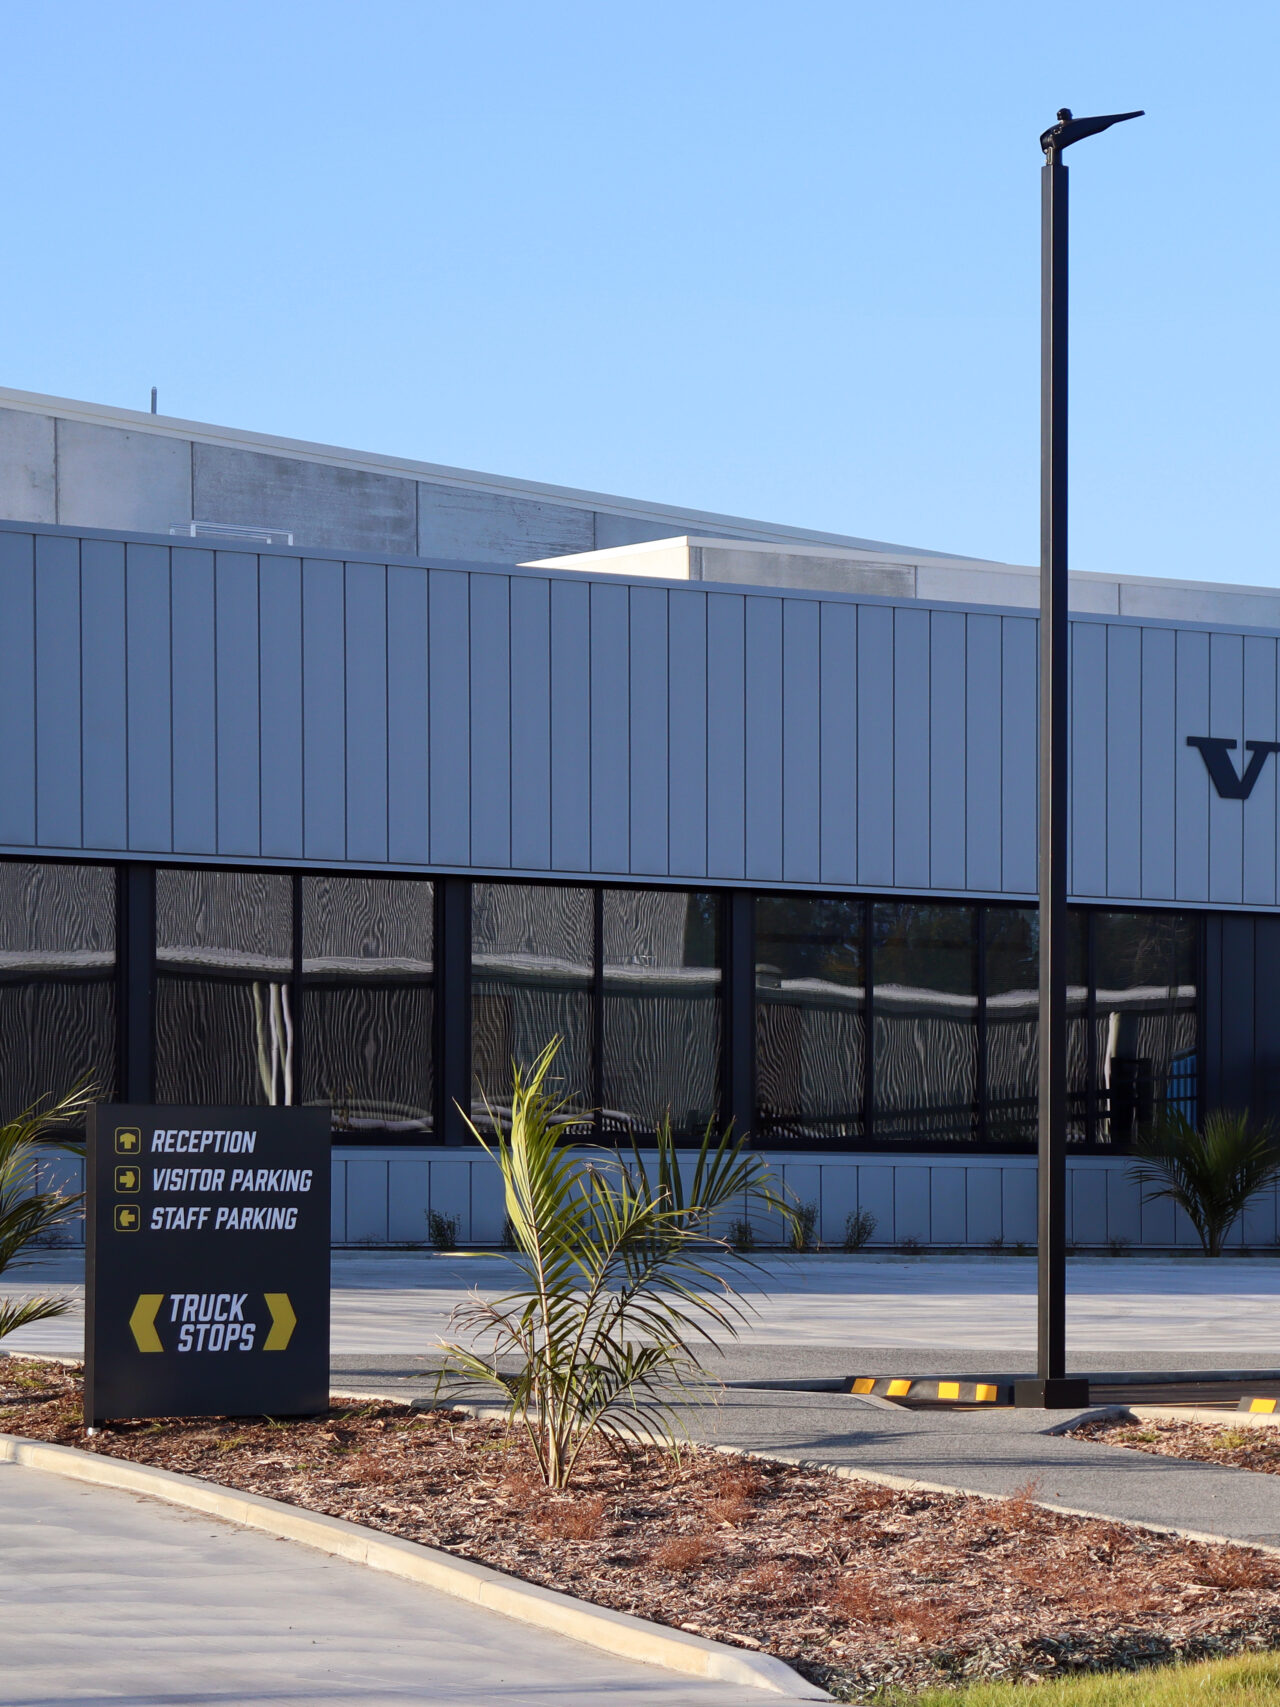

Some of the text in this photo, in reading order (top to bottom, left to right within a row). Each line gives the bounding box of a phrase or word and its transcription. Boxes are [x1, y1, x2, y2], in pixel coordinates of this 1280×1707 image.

[151, 1130, 257, 1153] RECEPTION
[152, 1168, 313, 1192] VISITOR PARKING
[150, 1207, 298, 1230] STAFF PARKING
[170, 1294, 248, 1322] TRUCK
[178, 1323, 256, 1352] STOPS
